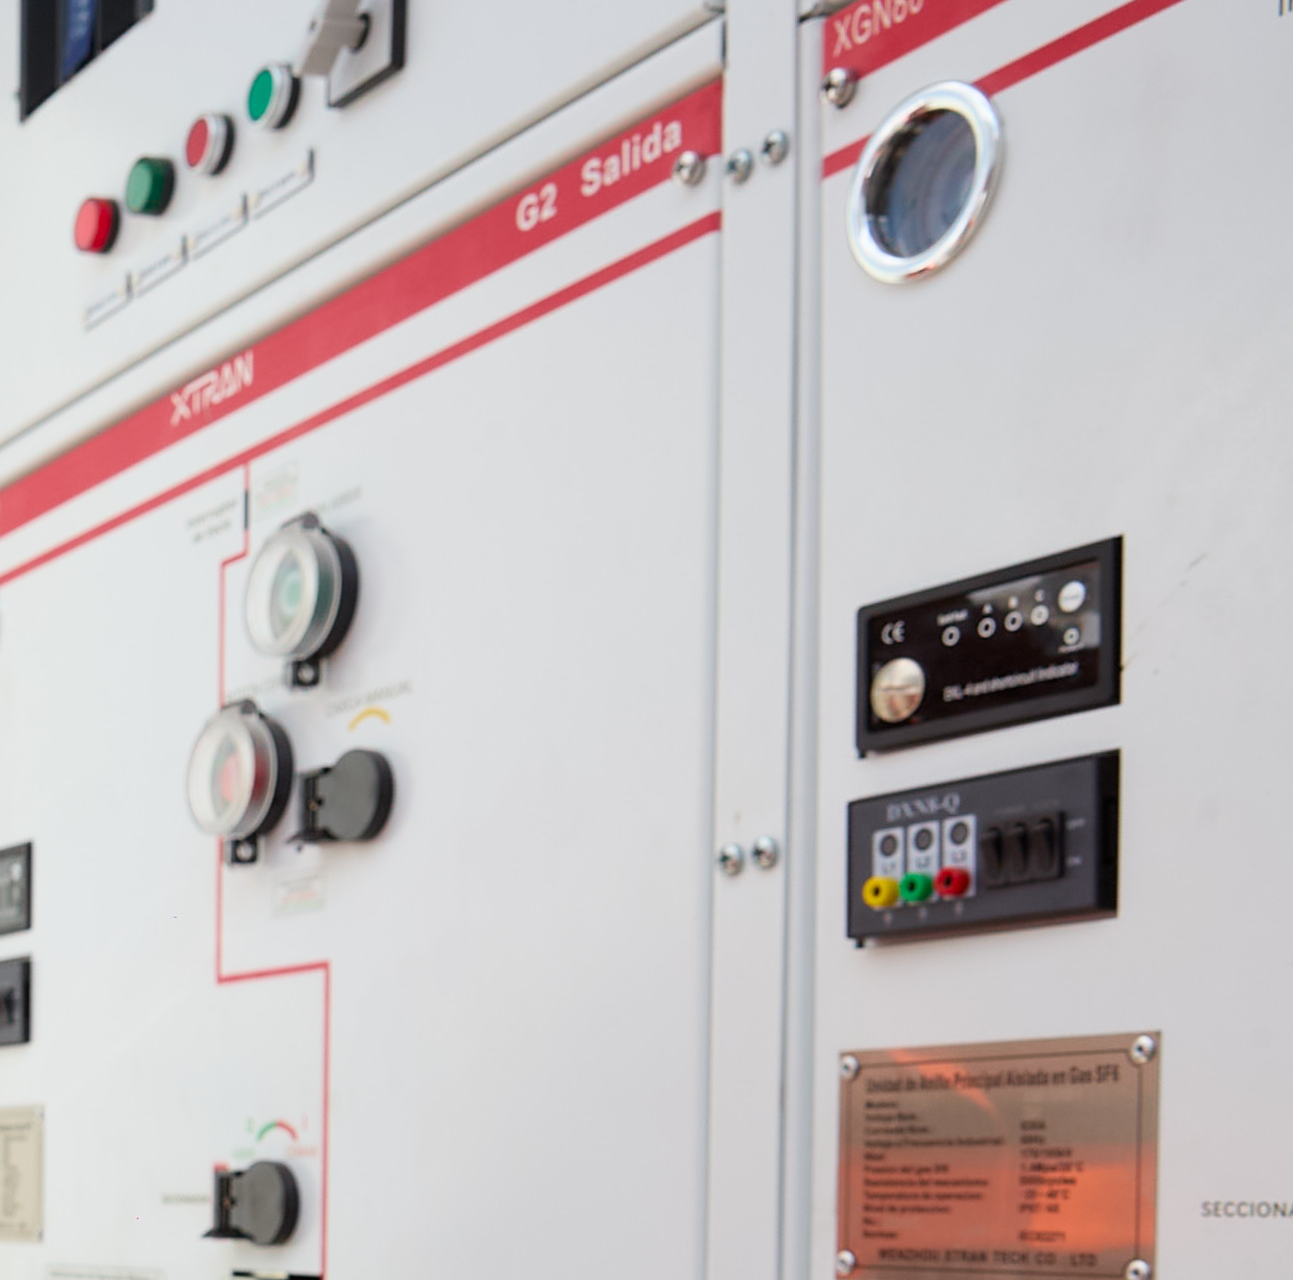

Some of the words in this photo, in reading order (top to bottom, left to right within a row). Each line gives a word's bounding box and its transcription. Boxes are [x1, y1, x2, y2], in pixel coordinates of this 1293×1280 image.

[516, 182, 557, 231] G2
[580, 120, 682, 197] Salida
[169, 349, 254, 428] XTRAN
